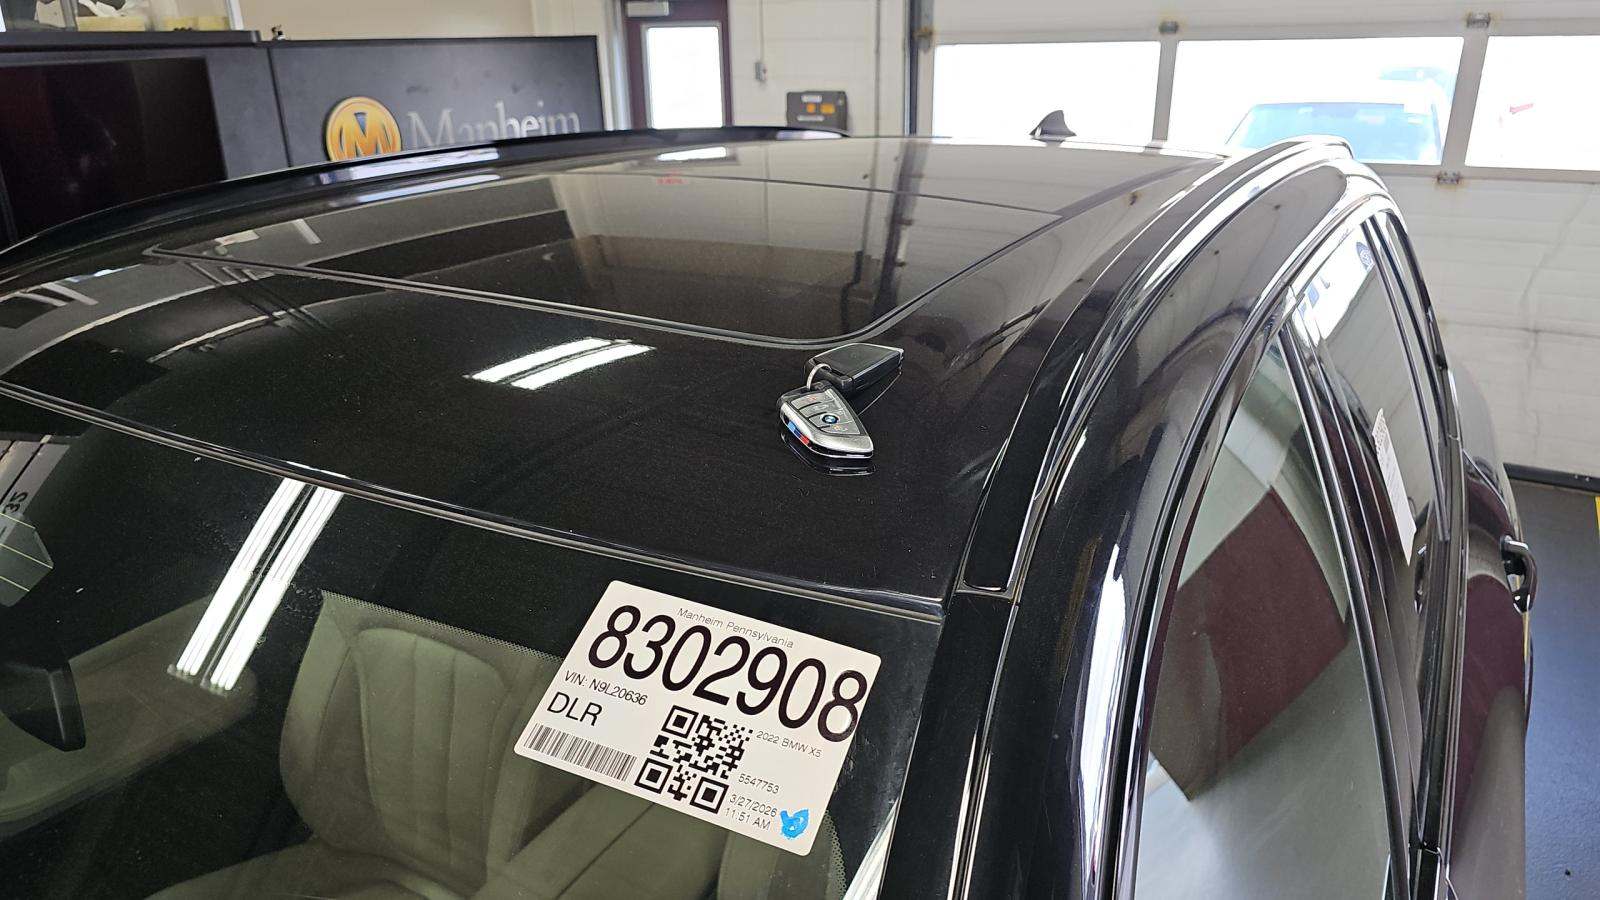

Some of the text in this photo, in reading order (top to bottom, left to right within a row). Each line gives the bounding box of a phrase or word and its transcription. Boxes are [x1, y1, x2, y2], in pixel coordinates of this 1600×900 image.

[408, 101, 580, 147] Manheim
[677, 608, 794, 649] Manheim Pennsylvania
[565, 670, 648, 706] VIN: N9L20636
[588, 605, 867, 742] 8302908
[547, 691, 603, 727] DLR
[756, 730, 822, 758] 2022 BMW X5
[738, 773, 780, 794] 5547753
[725, 807, 771, 831] 11:51 AM
[729, 793, 778, 818] 3/27/2026
